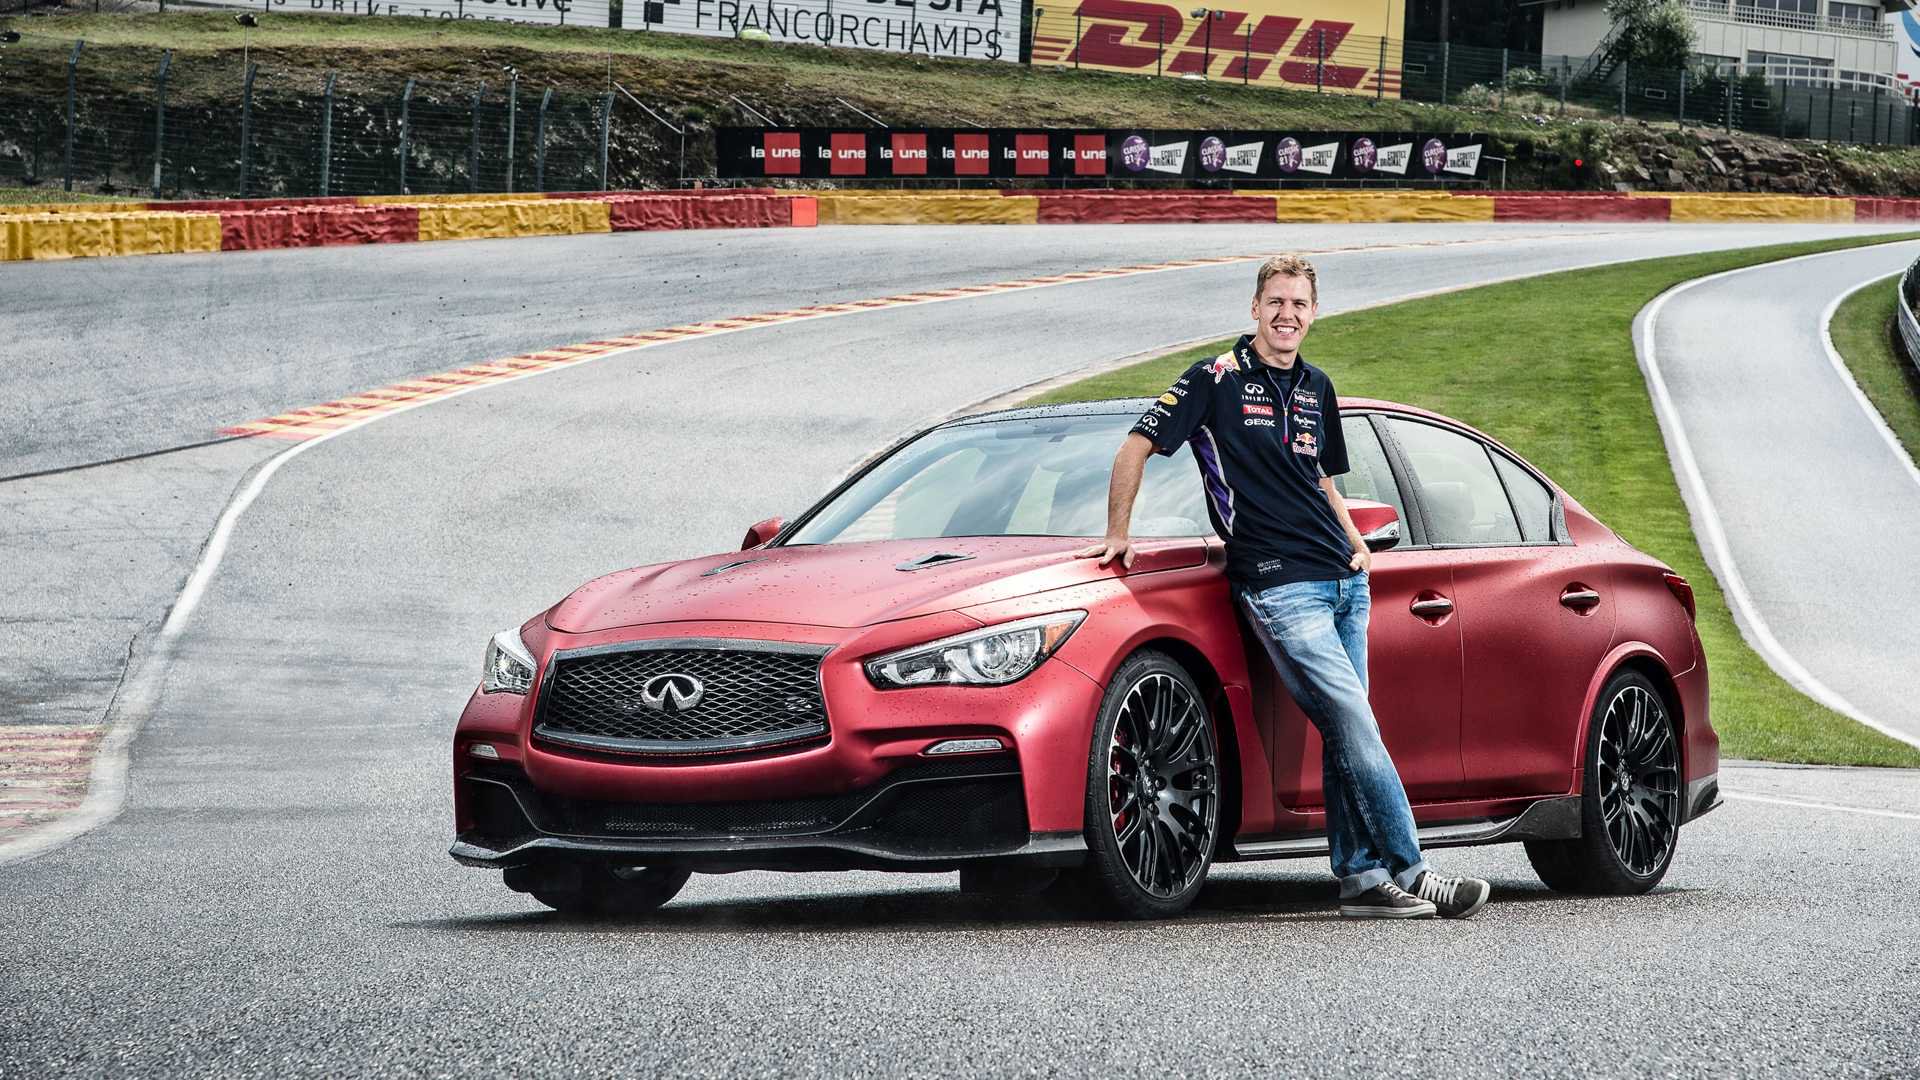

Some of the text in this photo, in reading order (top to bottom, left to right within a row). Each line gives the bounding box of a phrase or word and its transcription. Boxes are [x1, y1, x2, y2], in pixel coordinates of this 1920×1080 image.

[694, 0, 1003, 60] FRANCORCHAMPS
[1065, 0, 1368, 89] DHL
[751, 146, 801, 158] la une
[818, 146, 866, 158] la une
[880, 146, 927, 159] la une
[942, 147, 989, 159] la une
[1004, 147, 1049, 159] la une
[1063, 147, 1106, 160] la une
[1247, 405, 1271, 416] TOTAL
[1244, 418, 1275, 427] GEOX
